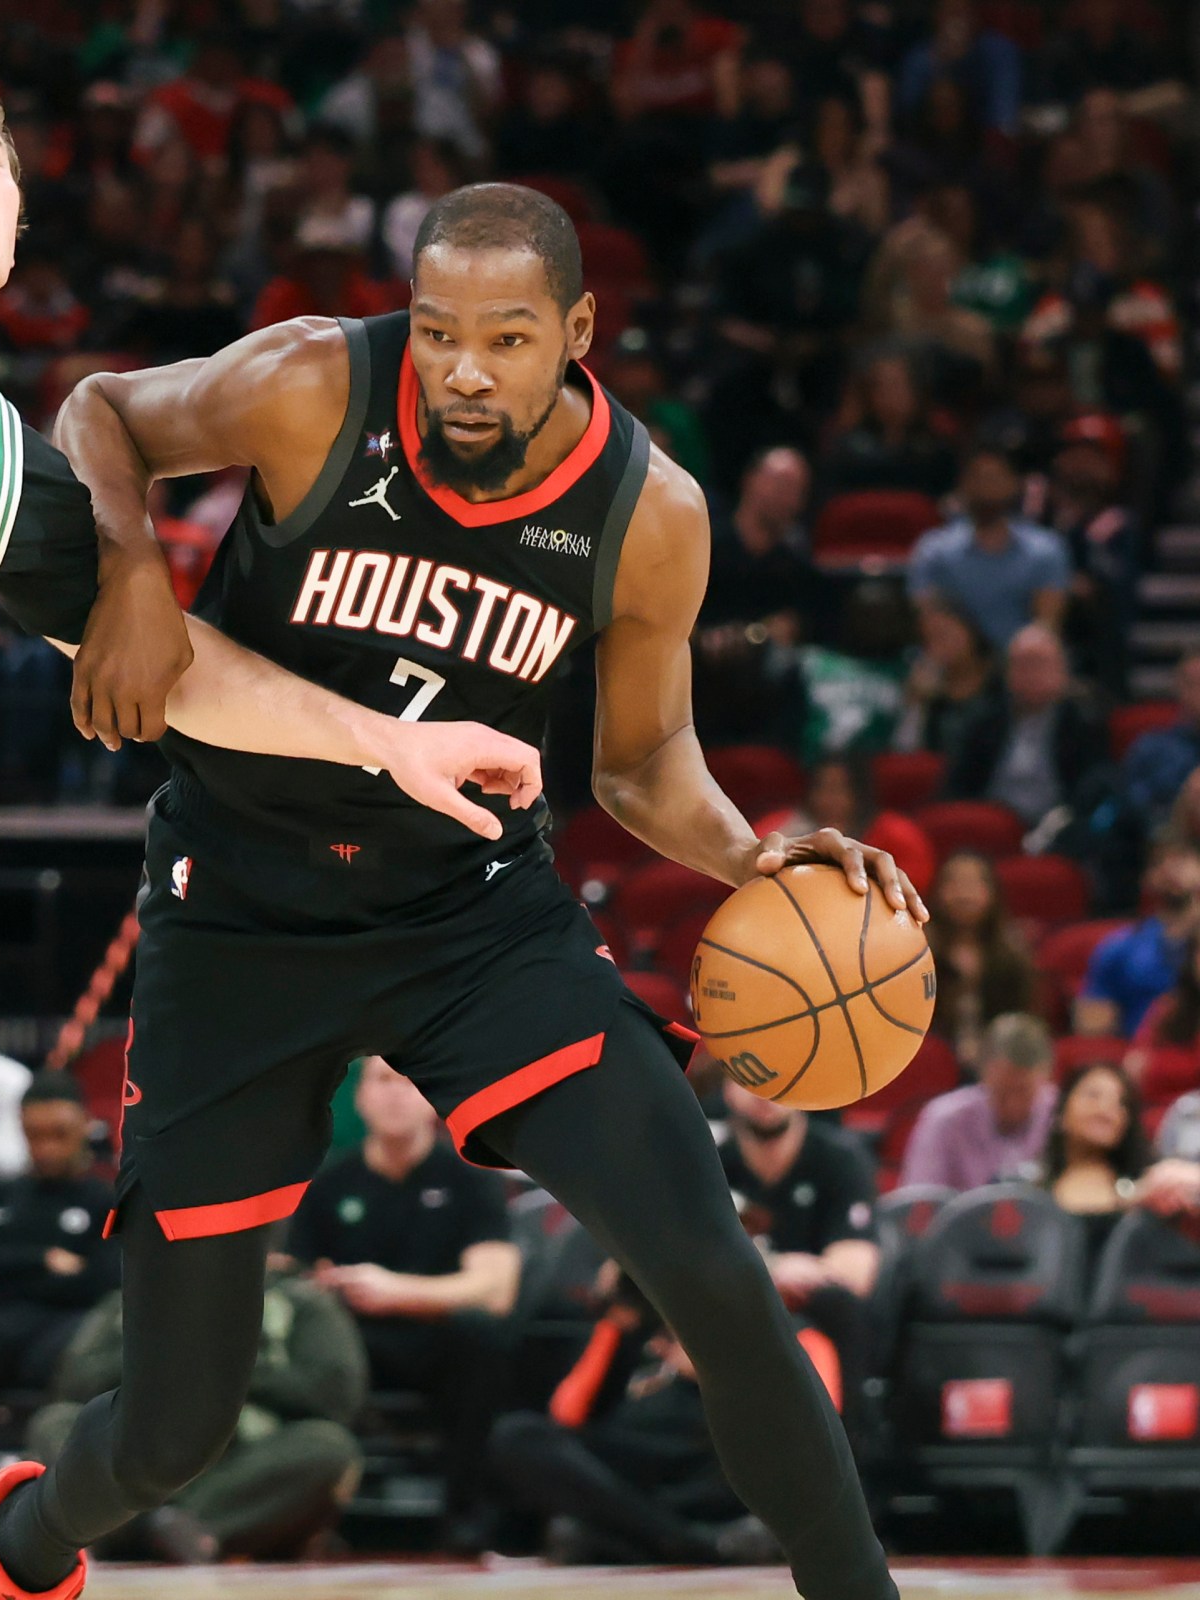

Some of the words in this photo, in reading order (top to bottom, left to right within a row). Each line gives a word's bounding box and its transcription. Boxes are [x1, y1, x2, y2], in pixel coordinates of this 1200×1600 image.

[519, 533, 591, 558] HERMANN
[521, 524, 592, 549] MEMORIAL
[289, 548, 578, 685] HOUSTON
[388, 656, 446, 723] 7
